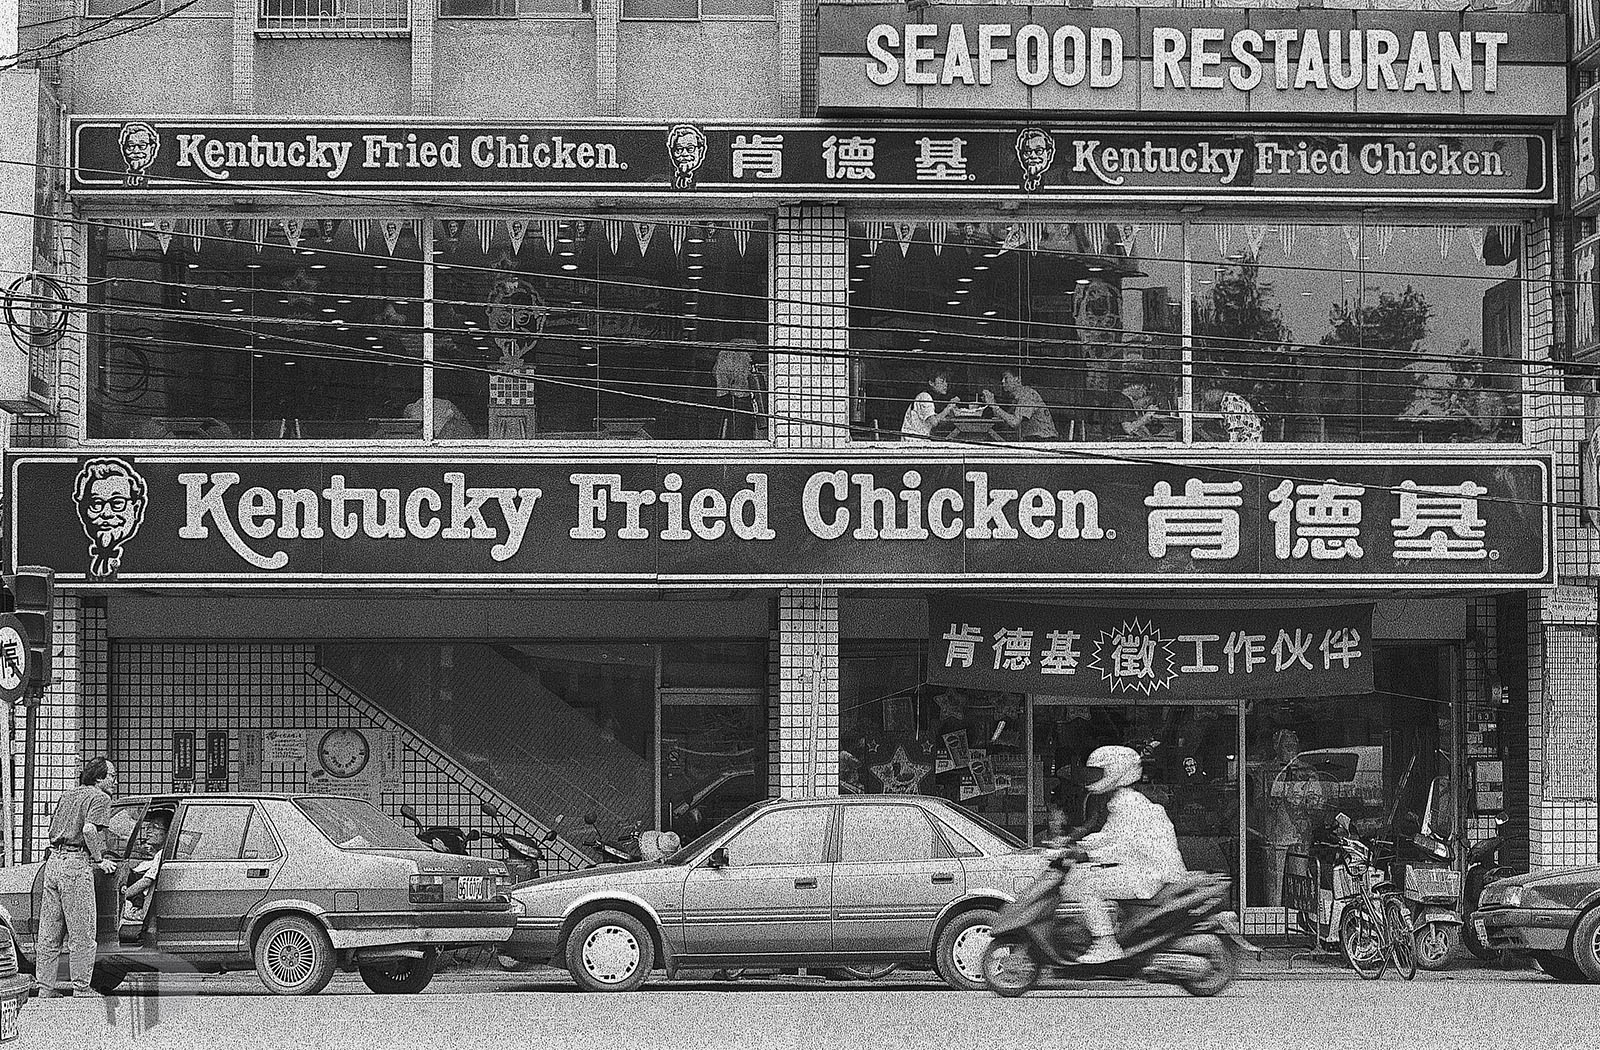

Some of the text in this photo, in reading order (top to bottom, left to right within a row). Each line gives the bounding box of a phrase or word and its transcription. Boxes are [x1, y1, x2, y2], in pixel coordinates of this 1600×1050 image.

[866, 24, 1509, 92] SEAFOOD RESTAURANT
[176, 134, 353, 180] Kentucky
[362, 133, 462, 169] Fried
[731, 134, 968, 181] 肯德基
[1072, 140, 1244, 184] Kentucky
[1255, 141, 1351, 175] Fried
[178, 472, 543, 570] Kentucky
[570, 472, 776, 541] Fried
[1144, 478, 1488, 560] 肯德基
